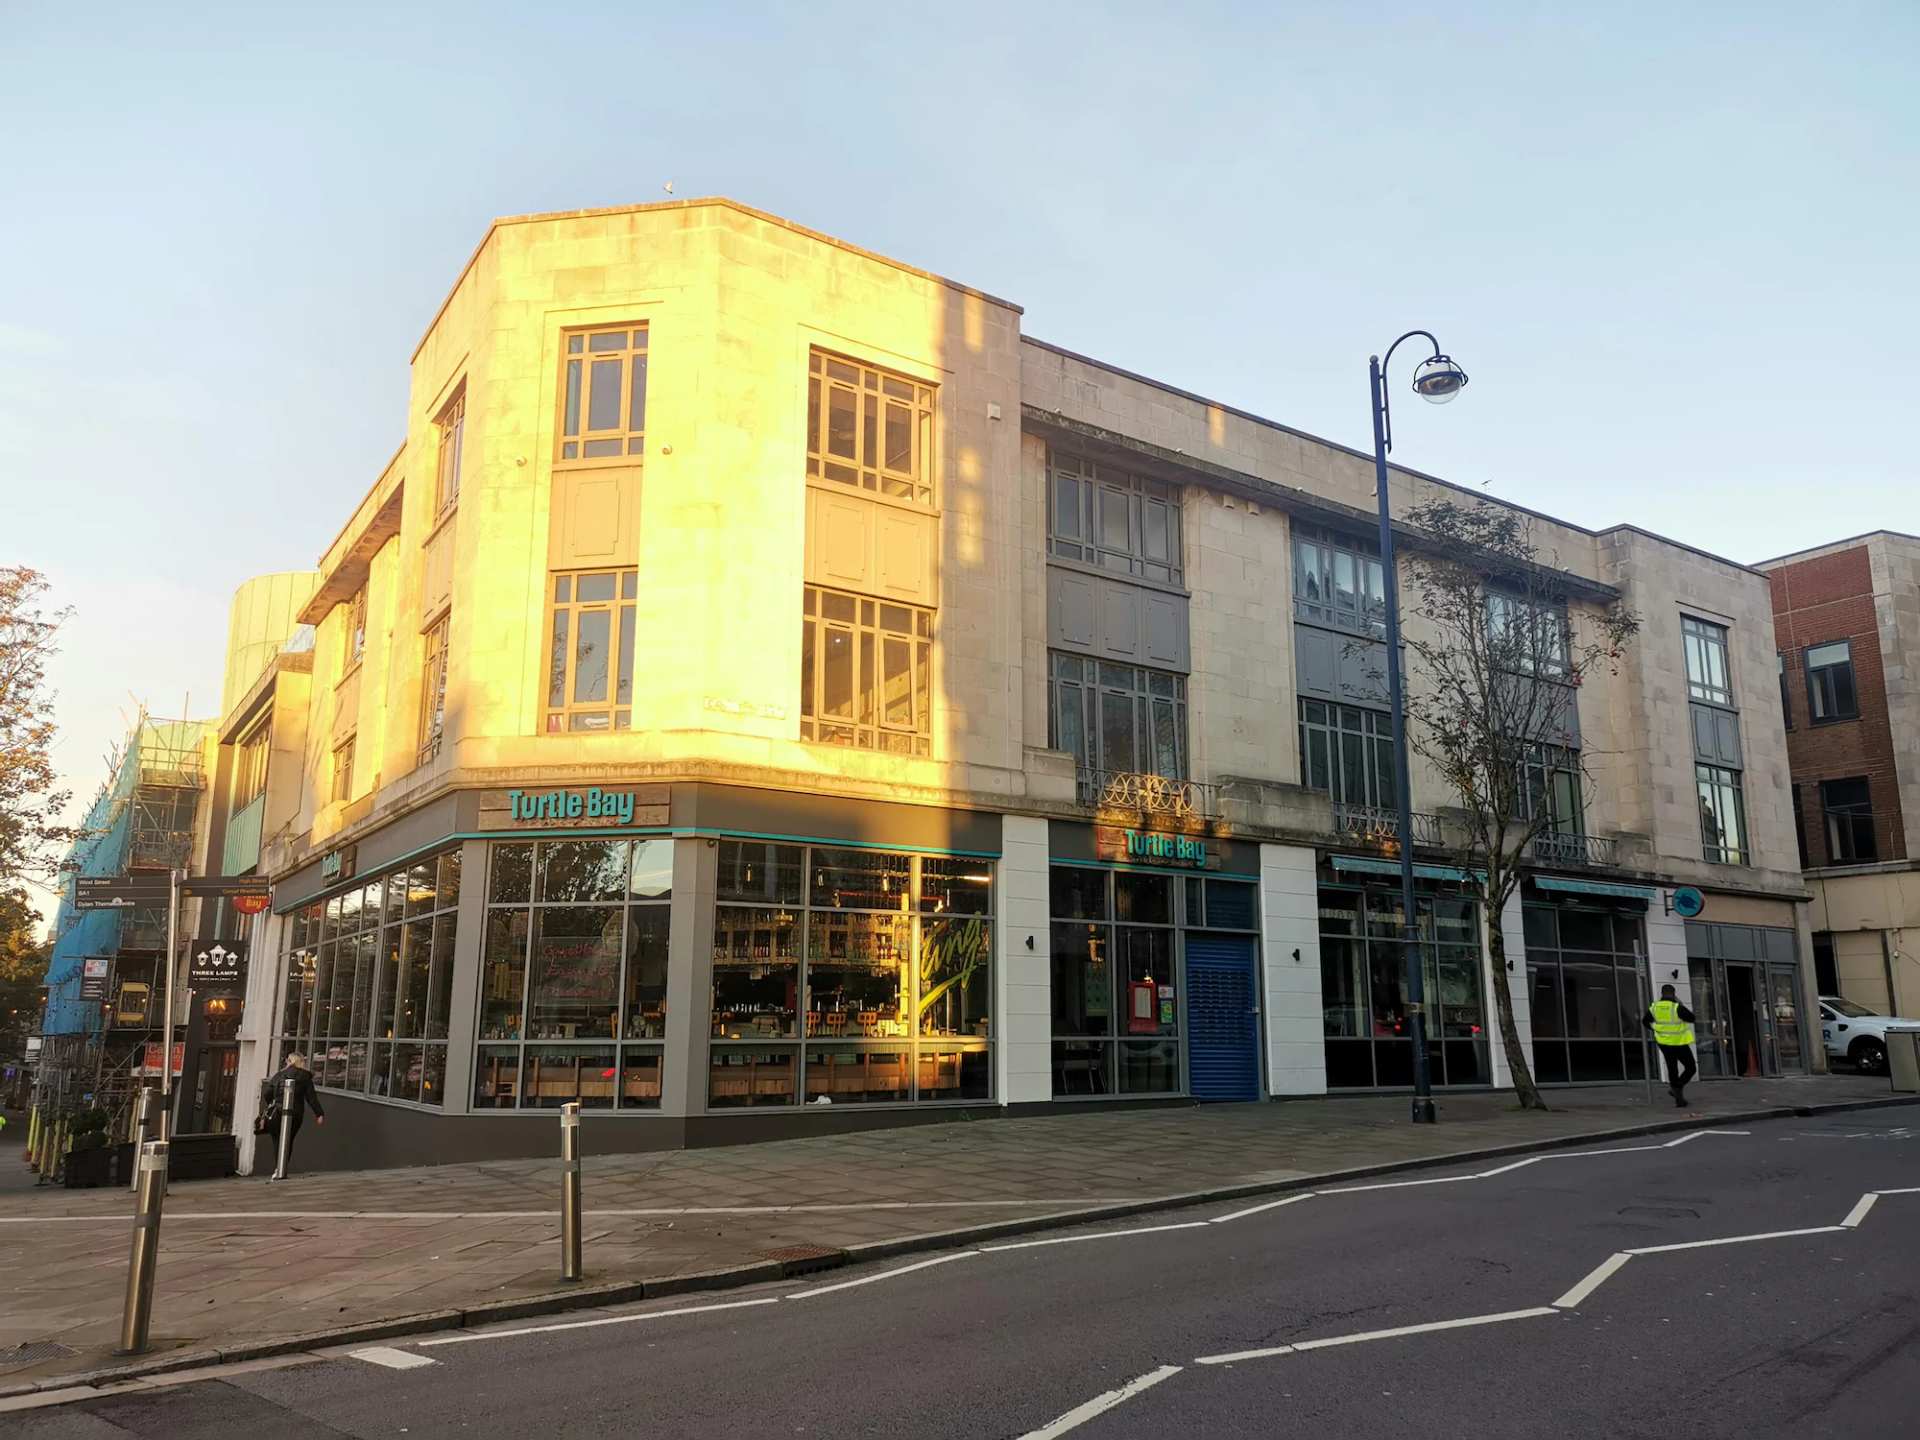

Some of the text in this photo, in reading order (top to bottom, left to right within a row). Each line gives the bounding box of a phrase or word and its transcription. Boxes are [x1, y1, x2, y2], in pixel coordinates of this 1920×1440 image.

[508, 787, 635, 824] Turtle Bay
[1125, 828, 1206, 868] Turtle Bay
